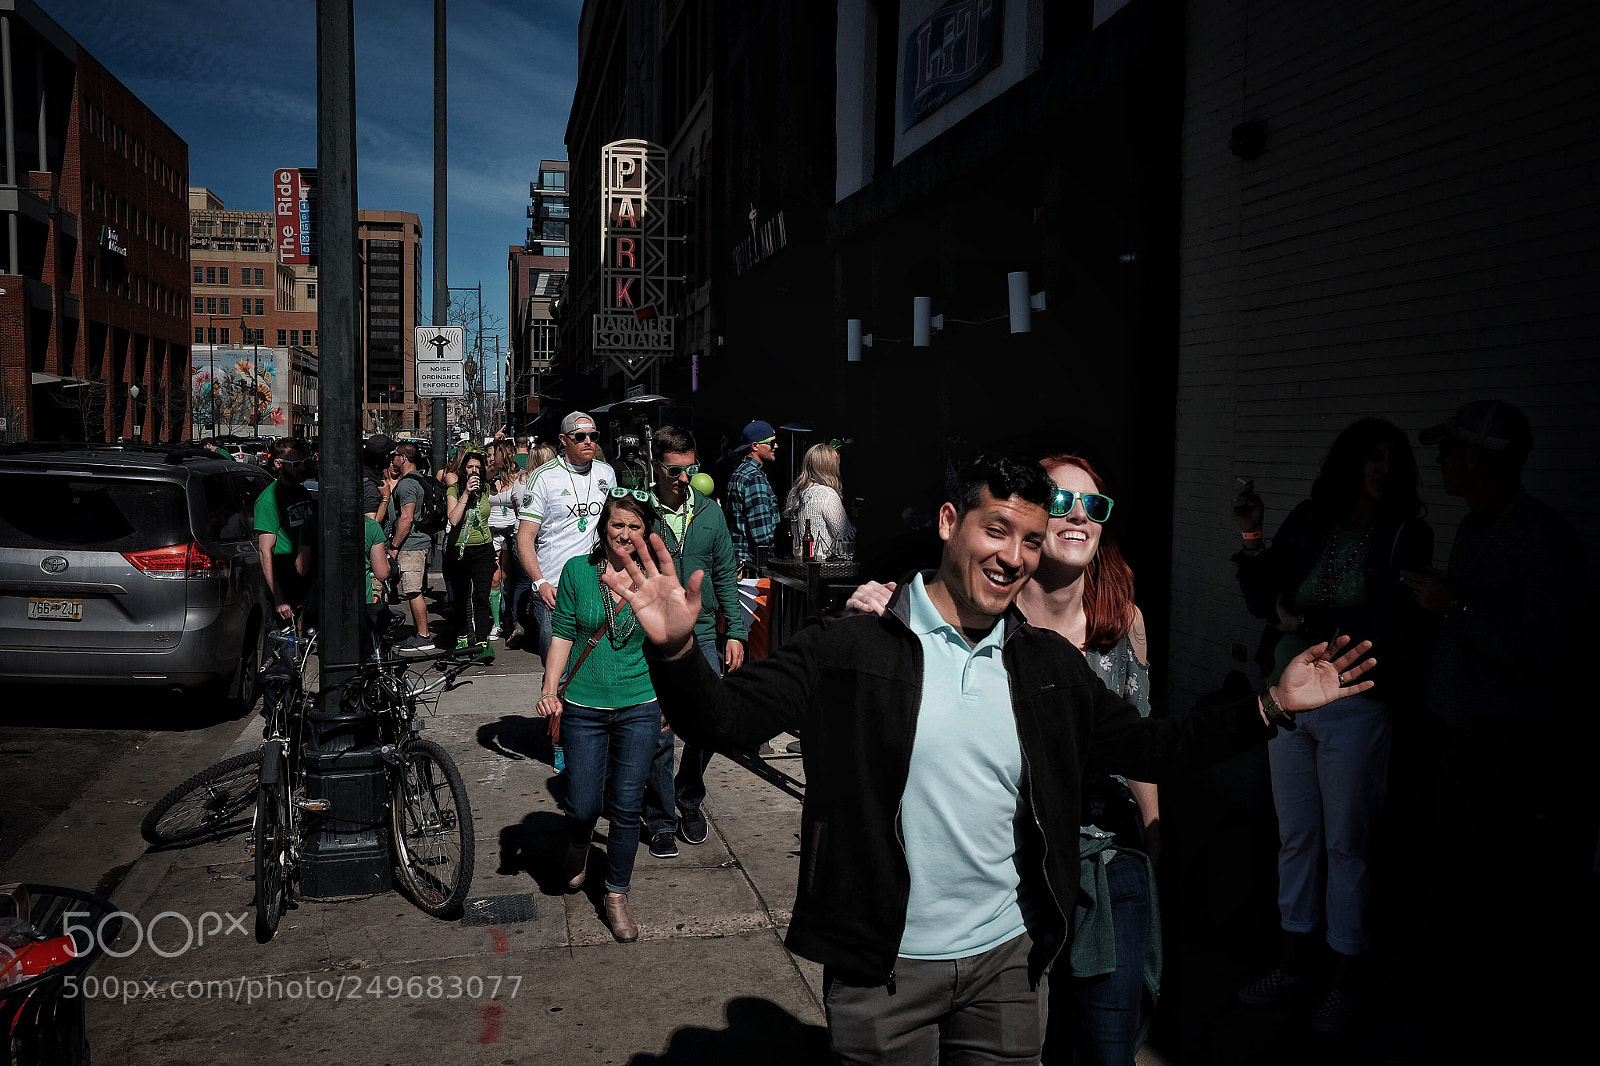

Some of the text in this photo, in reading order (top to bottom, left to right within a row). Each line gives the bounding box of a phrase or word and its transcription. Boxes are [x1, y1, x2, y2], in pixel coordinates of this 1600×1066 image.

[278, 171, 295, 262] The Ride
[616, 156, 638, 309] PARK
[600, 316, 669, 332] LARIMER
[599, 333, 669, 347] SQUARE
[31, 602, 50, 614] 766
